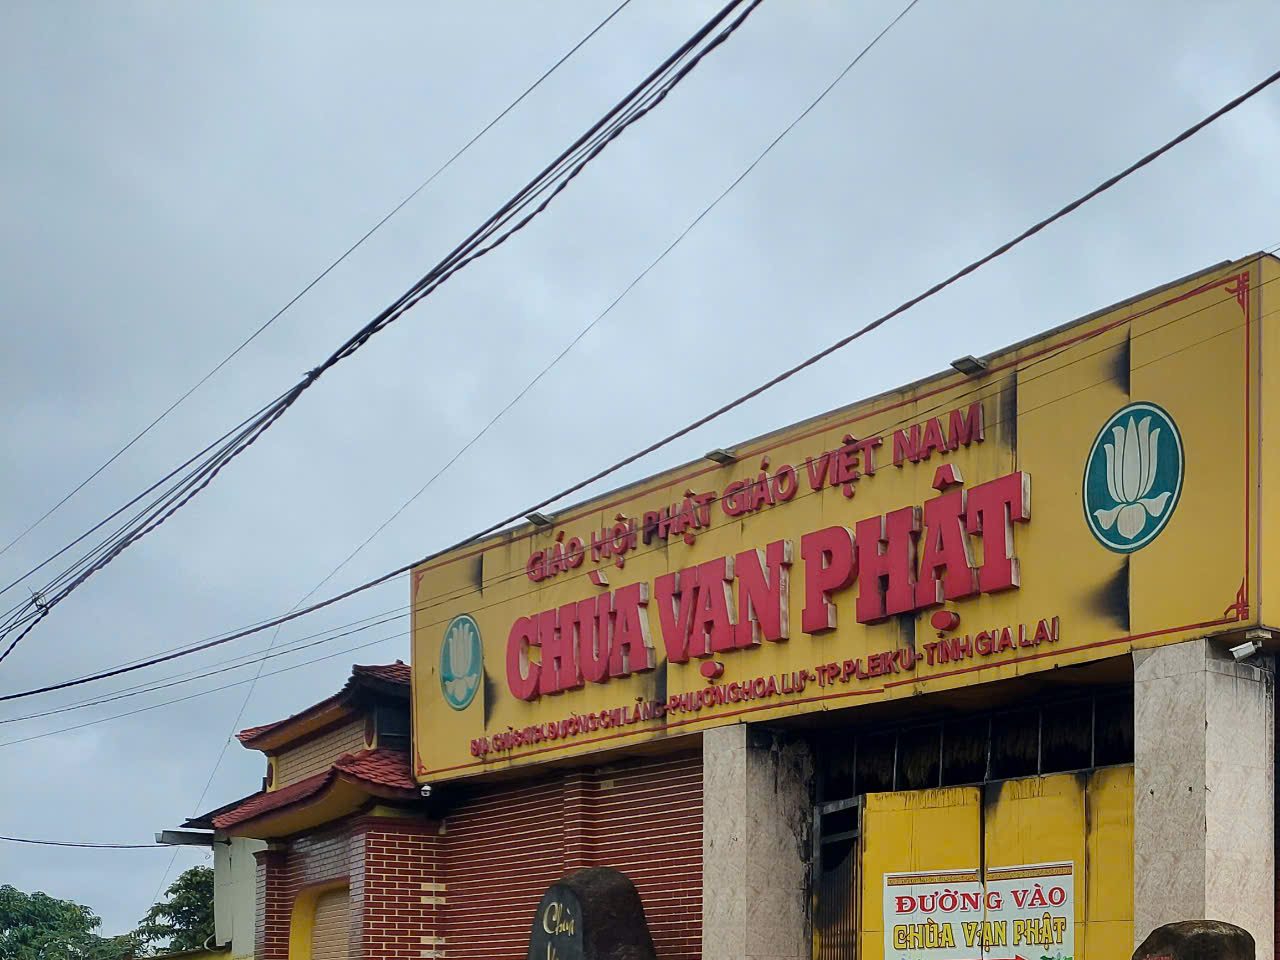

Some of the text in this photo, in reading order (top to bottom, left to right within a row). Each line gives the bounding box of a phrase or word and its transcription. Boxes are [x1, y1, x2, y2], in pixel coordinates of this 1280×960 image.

[526, 401, 985, 583] GIÁO HỘI PHẬT GIÁO VIỆT NAM
[506, 463, 1032, 700] CHÙA VẠN PHẬT
[741, 674, 781, 702] HOA
[974, 625, 1017, 656] GIA
[1018, 616, 1060, 648] LAI
[893, 911, 1067, 952] CHÙA VẠN PHẬT
[894, 883, 1067, 914] ĐƯỜNG VÀO
